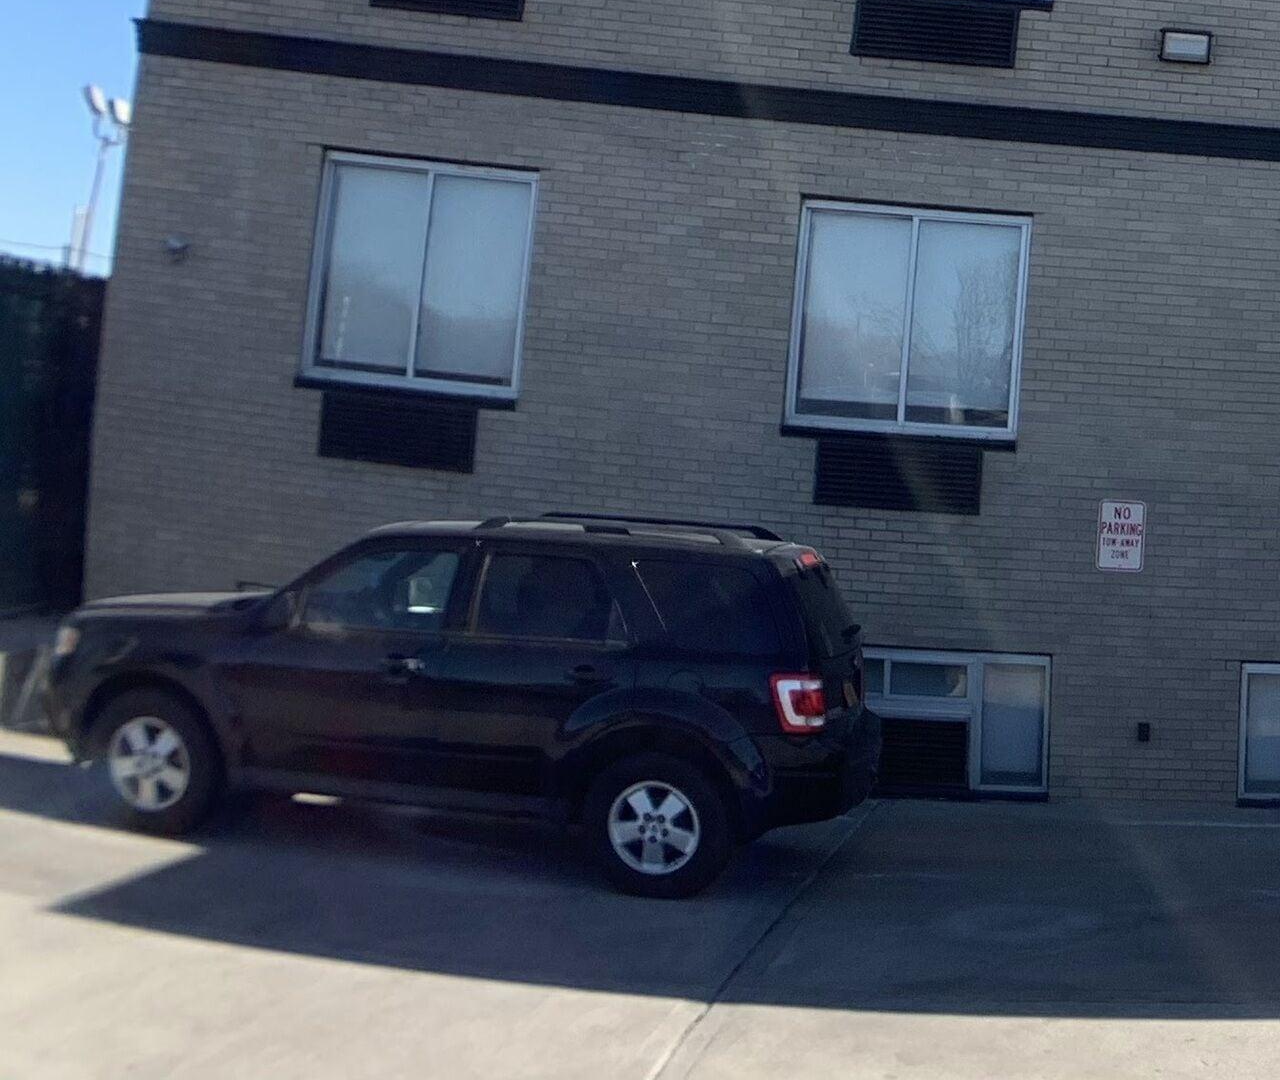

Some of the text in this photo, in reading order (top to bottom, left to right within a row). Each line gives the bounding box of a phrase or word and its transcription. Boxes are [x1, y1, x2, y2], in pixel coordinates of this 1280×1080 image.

[1113, 506, 1132, 520] NO
[1101, 522, 1144, 536] PARKING
[1110, 550, 1129, 560] ZONE
